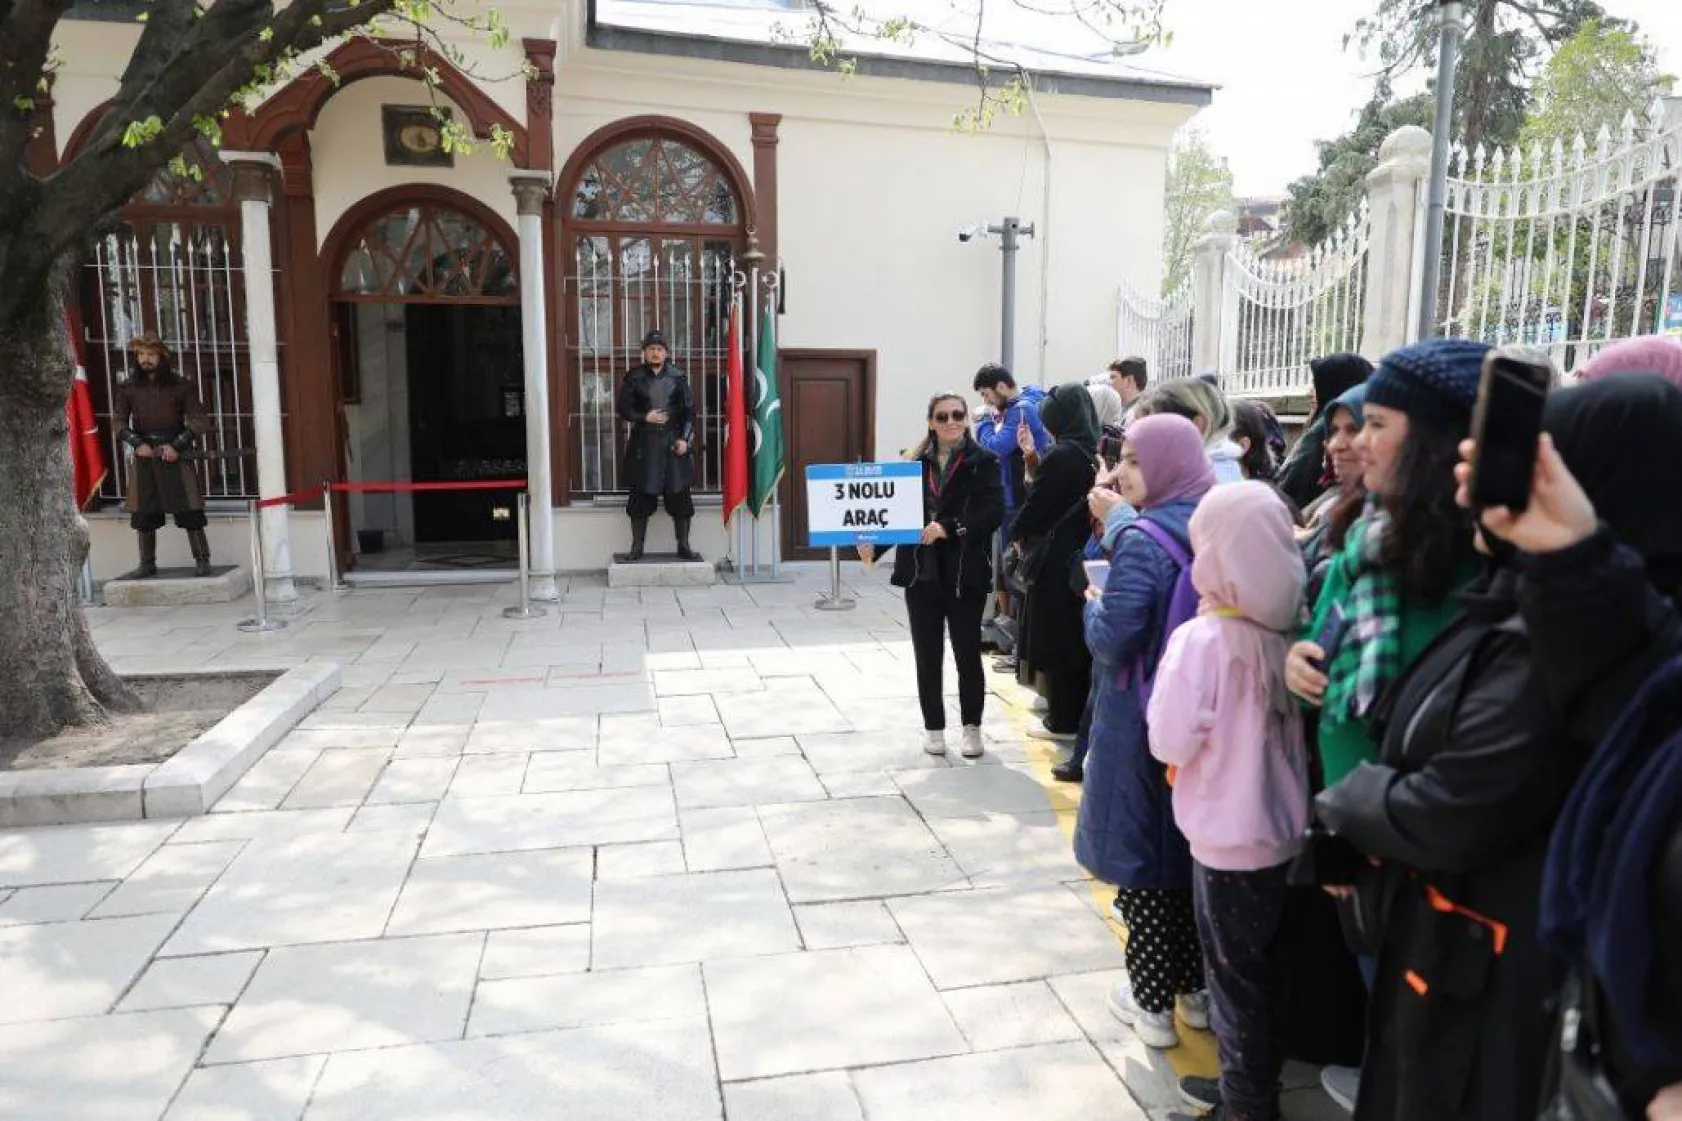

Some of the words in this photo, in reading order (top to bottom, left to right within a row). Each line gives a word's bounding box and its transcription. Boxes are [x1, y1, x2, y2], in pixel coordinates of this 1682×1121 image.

[834, 483, 845, 500] 3
[849, 481, 895, 499] NOLU
[843, 508, 889, 528] ARAÇ
